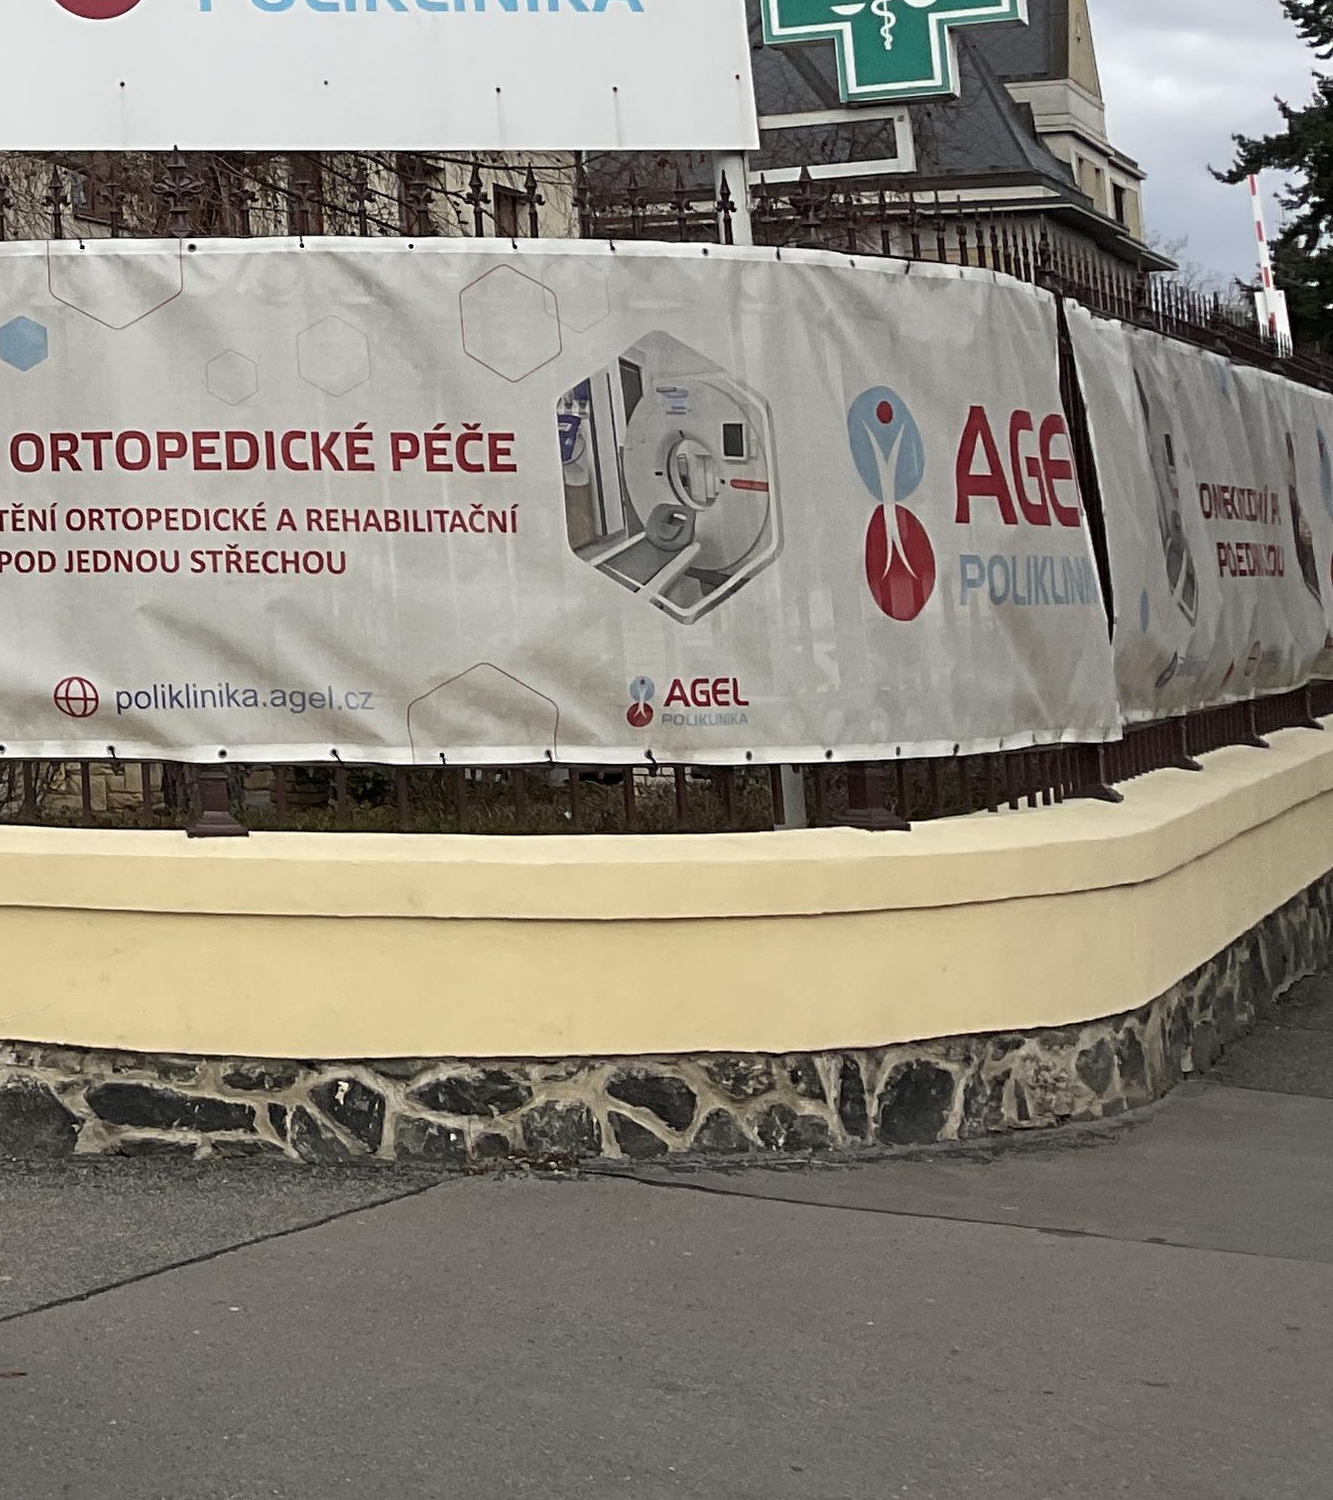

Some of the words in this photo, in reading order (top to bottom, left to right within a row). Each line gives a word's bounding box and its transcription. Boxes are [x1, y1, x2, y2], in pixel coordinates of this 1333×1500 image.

[9, 422, 376, 473] ORTOPEDICKÉ
[389, 422, 518, 473] PÉČE
[955, 405, 1081, 527] AGE
[65, 502, 267, 532] ORTOPEDICKÉ
[276, 508, 297, 532] A
[306, 503, 520, 534] REHABILITAČNÍ
[63, 549, 181, 574] JEDNOU
[189, 543, 347, 575] STŘECHOU
[116, 682, 375, 714] poliklinika.agel.cz
[663, 677, 750, 708] AGEL
